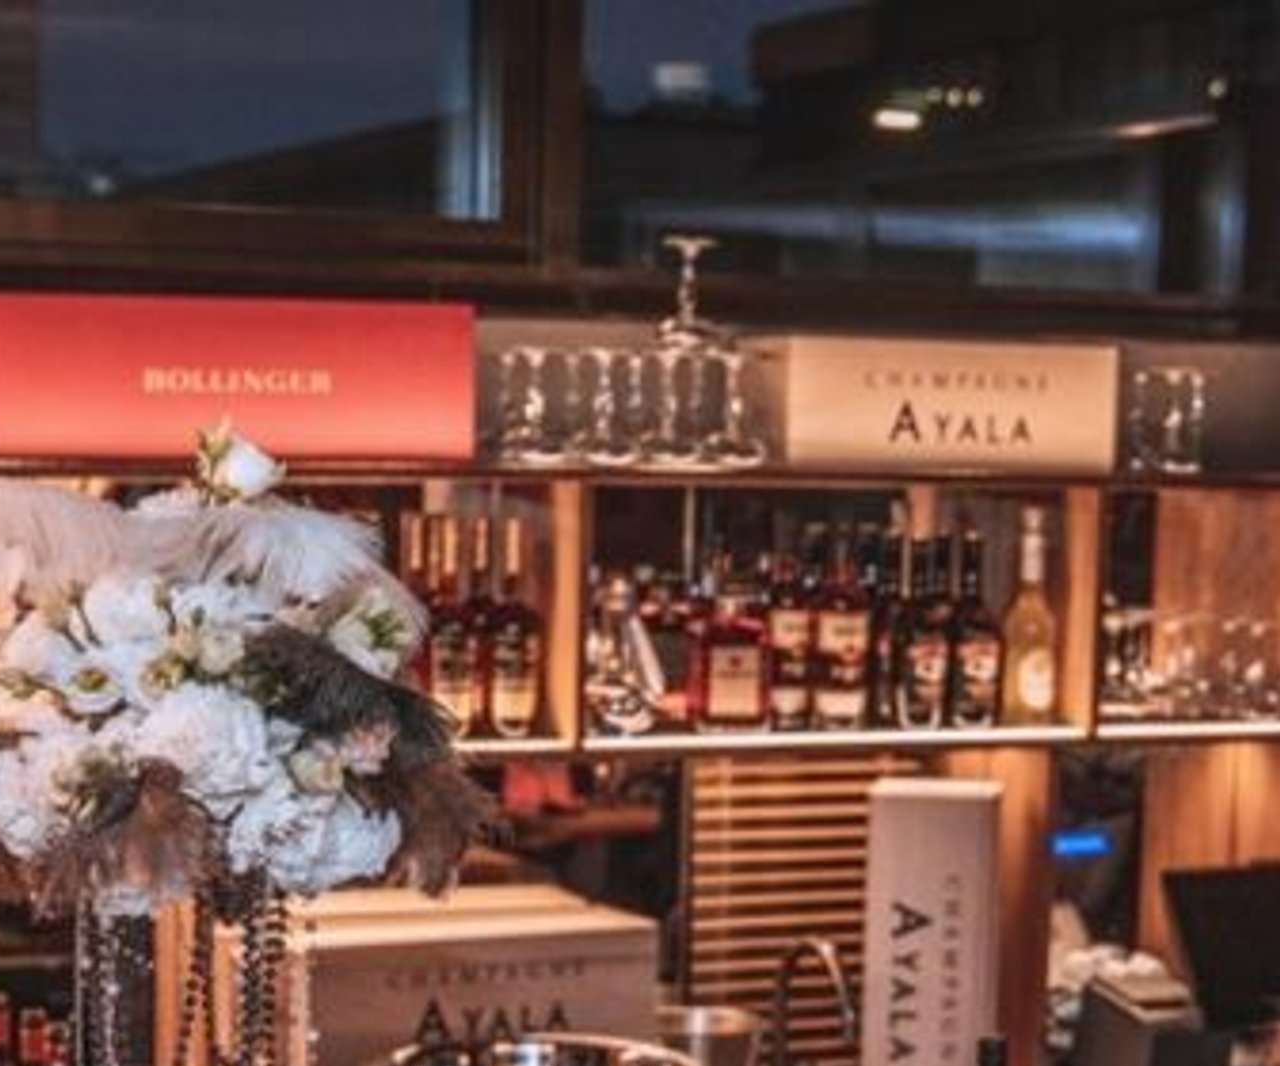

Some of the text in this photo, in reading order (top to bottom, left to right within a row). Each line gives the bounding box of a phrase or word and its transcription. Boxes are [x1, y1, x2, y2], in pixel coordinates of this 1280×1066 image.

[887, 399, 1034, 444] AYALA
[888, 901, 933, 1064] AYALA
[415, 997, 570, 1044] AYALA
